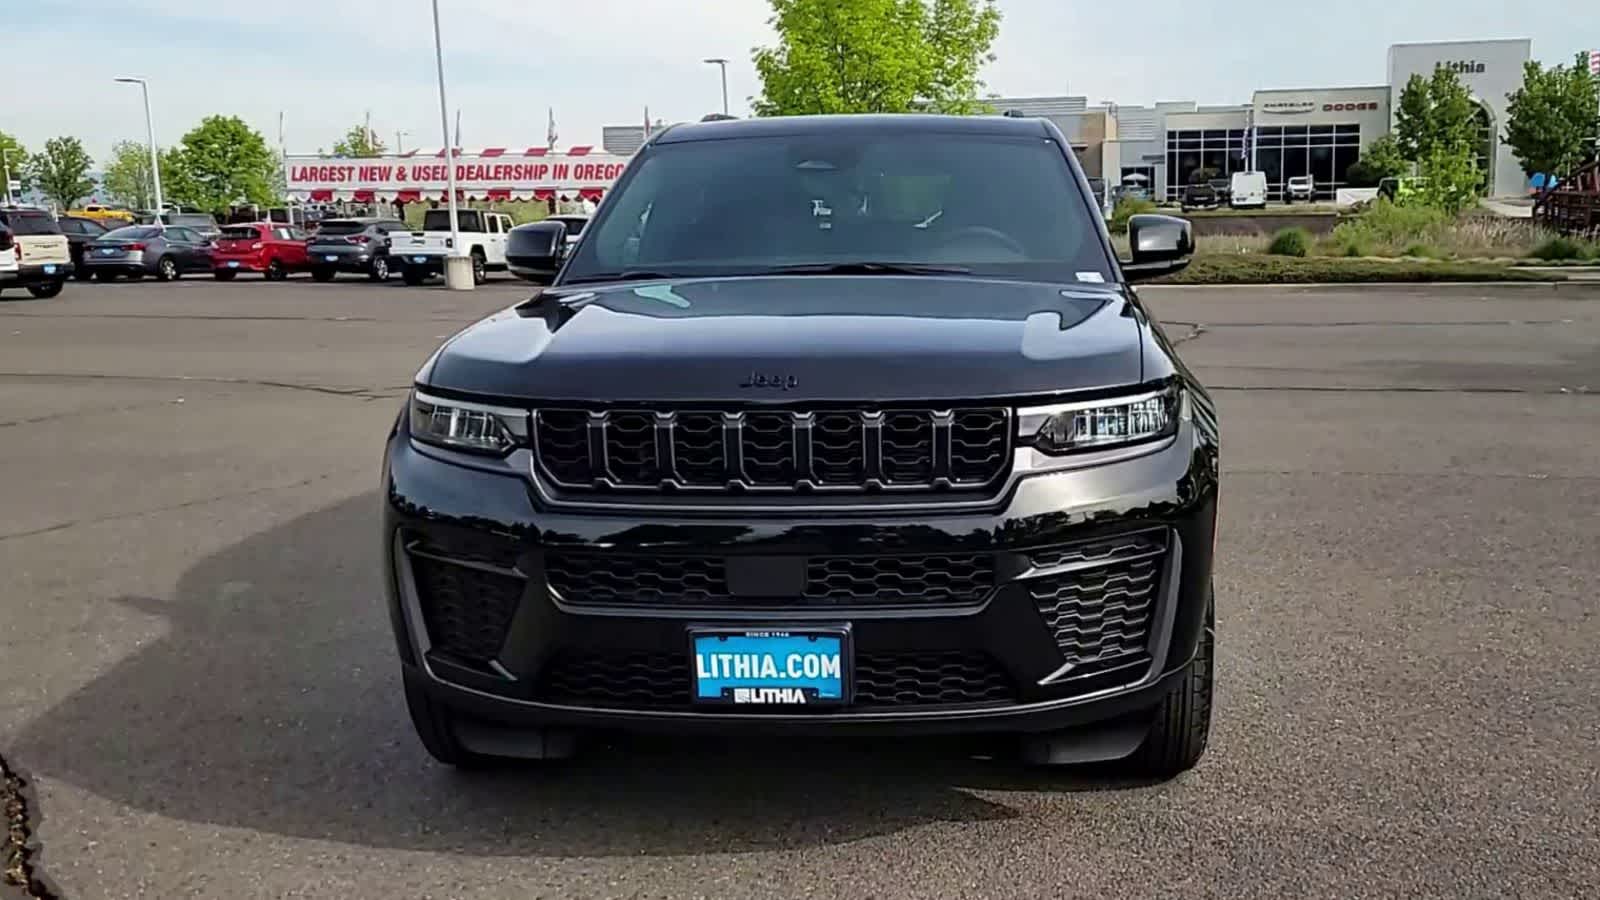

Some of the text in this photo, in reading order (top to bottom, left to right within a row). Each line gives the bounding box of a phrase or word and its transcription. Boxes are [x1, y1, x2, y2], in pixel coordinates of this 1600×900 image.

[1322, 102, 1378, 112] DODGE
[291, 166, 355, 182] LARGEST
[358, 166, 392, 182] NEW
[395, 166, 408, 182] &
[411, 165, 449, 182] USED
[455, 164, 548, 181] DEALERSHIP
[552, 164, 569, 180] IN
[738, 371, 800, 391] Jeep
[696, 653, 841, 679] LITHIA.COM
[750, 687, 806, 704] LITHIA
